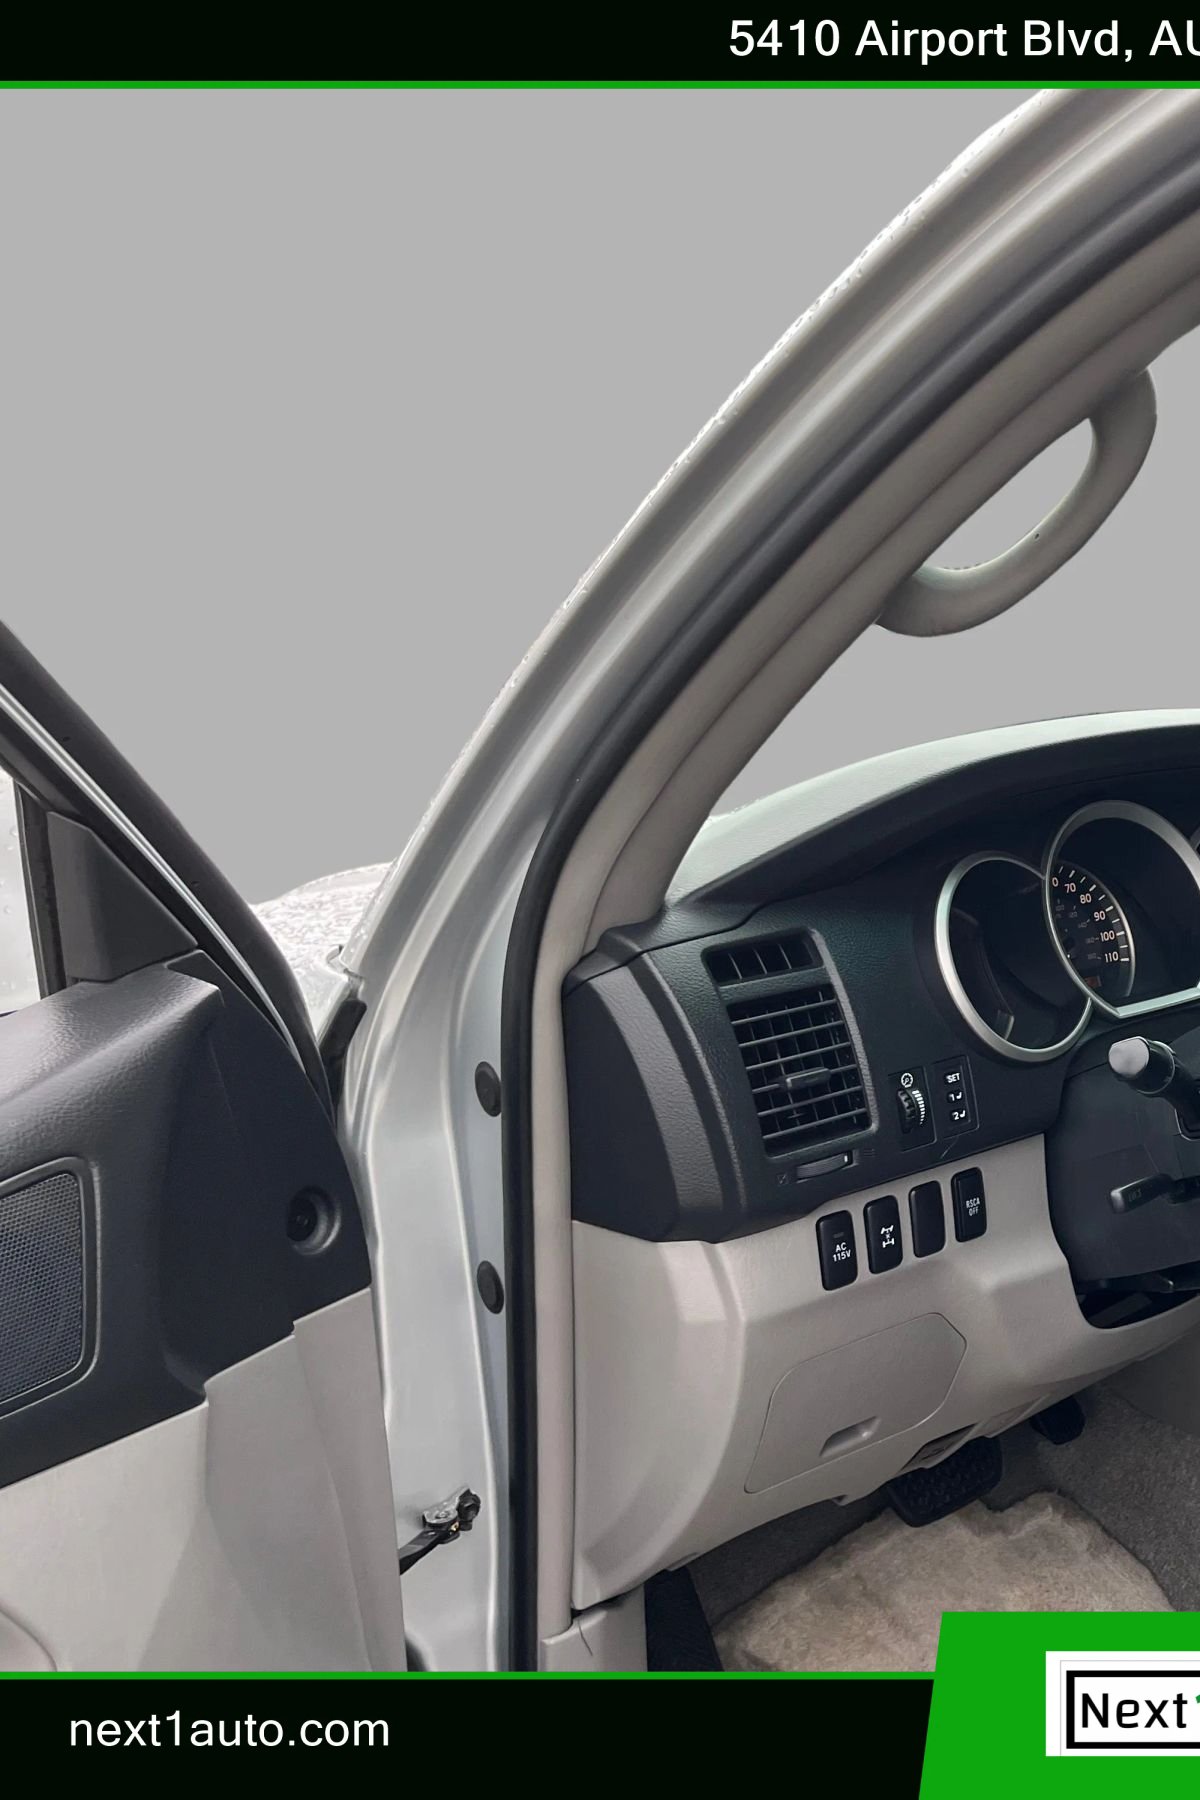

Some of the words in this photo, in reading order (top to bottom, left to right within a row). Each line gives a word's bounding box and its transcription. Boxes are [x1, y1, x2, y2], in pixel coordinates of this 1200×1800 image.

[1064, 883, 1076, 893] 70
[1080, 893, 1091, 904] 80
[1094, 910, 1105, 921] 90
[1100, 930, 1115, 941] 100
[1105, 951, 1119, 963] 110
[946, 1072, 960, 1084] SET
[949, 1093, 955, 1101] 1
[952, 1111, 960, 1120] 2
[968, 1207, 979, 1216] OFF
[835, 1242, 847, 1252] AC
[832, 1250, 851, 1262] 115V
